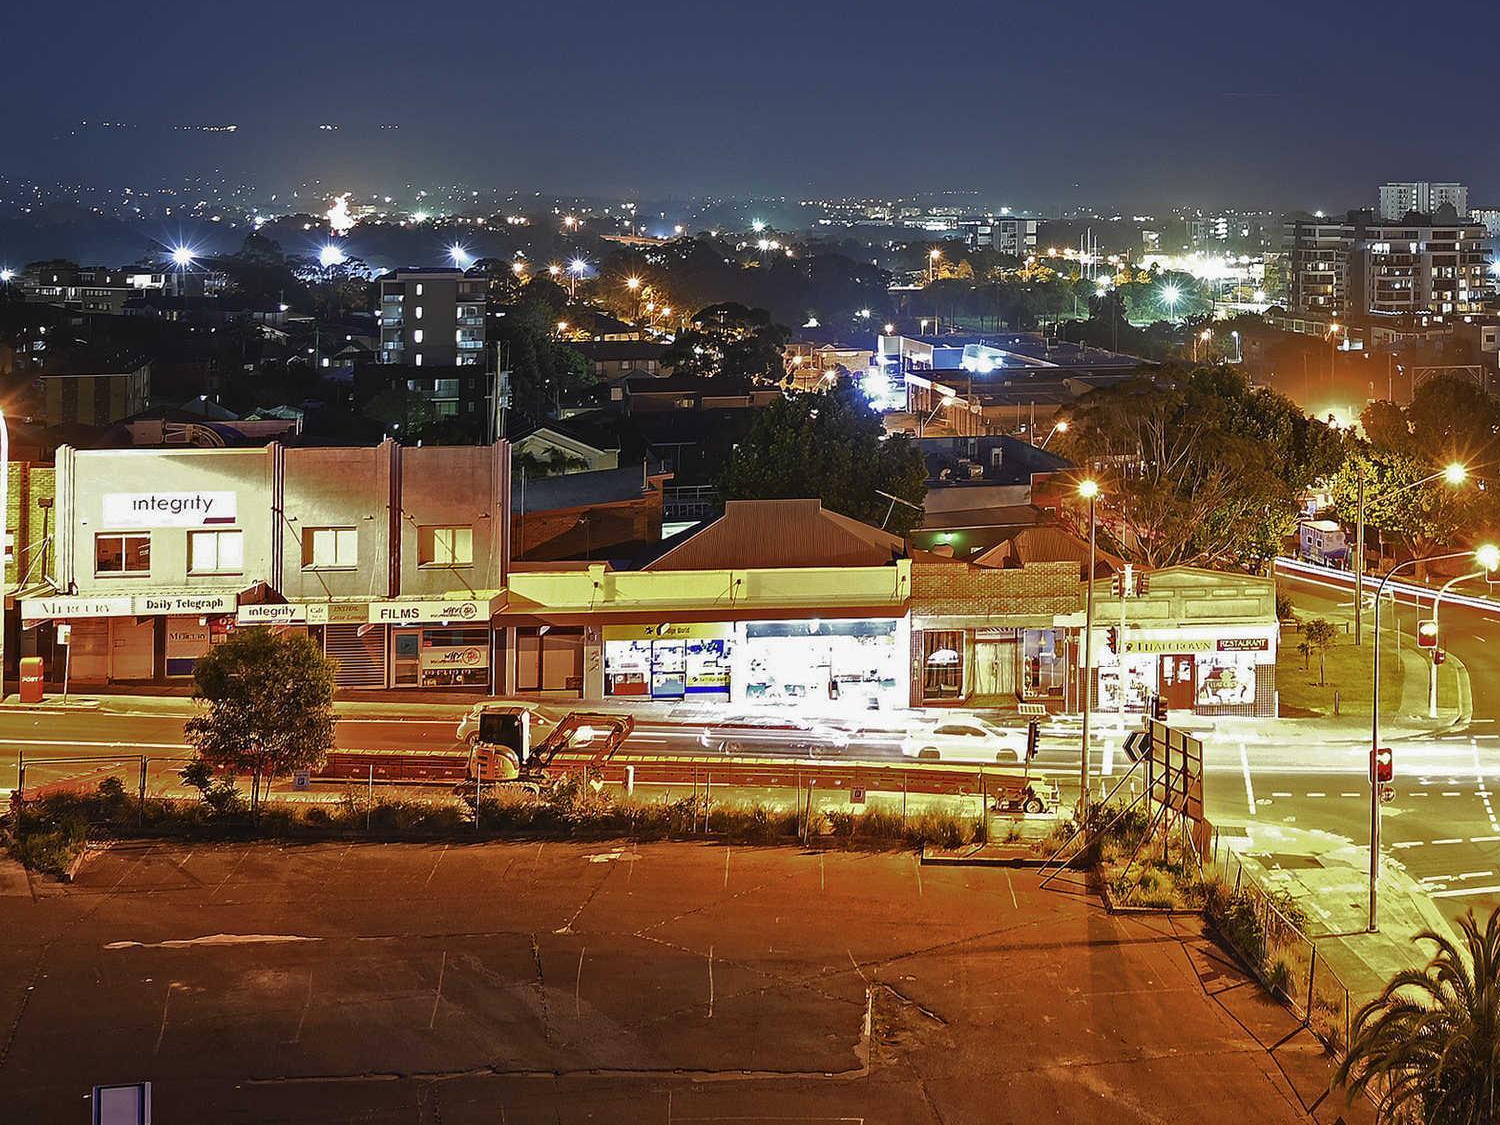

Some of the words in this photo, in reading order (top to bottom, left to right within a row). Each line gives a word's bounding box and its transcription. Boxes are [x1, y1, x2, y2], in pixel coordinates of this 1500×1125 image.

[132, 495, 213, 514] integrity
[146, 599, 173, 611] Daily
[176, 598, 224, 611] Telegraph
[248, 605, 296, 617] integrity
[380, 608, 420, 619] FILMS
